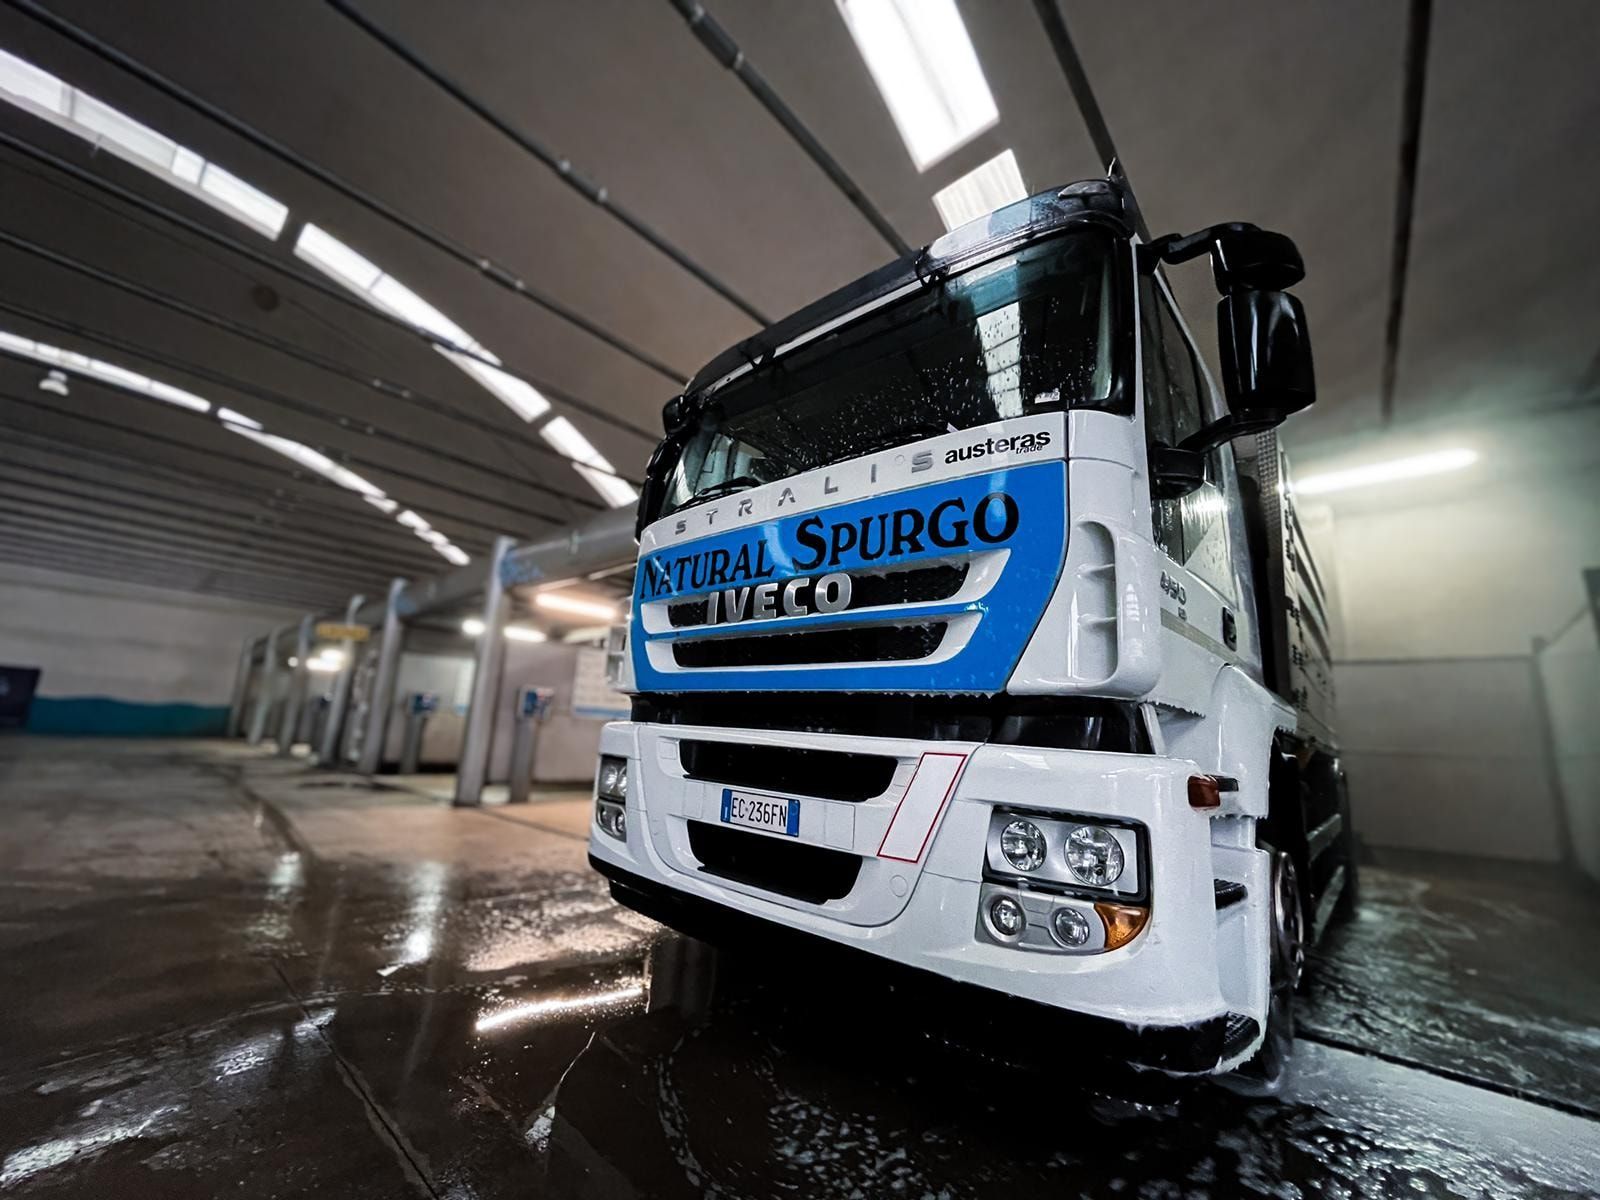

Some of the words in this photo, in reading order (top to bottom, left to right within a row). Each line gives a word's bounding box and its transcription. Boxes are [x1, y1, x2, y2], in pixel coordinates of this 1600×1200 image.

[944, 431, 1051, 464] austeras
[1015, 443, 1043, 455] trade
[675, 449, 934, 536] STRALIS
[640, 539, 775, 599] NATURAL
[791, 492, 1020, 572] SPURGO
[706, 572, 852, 625] IVECO
